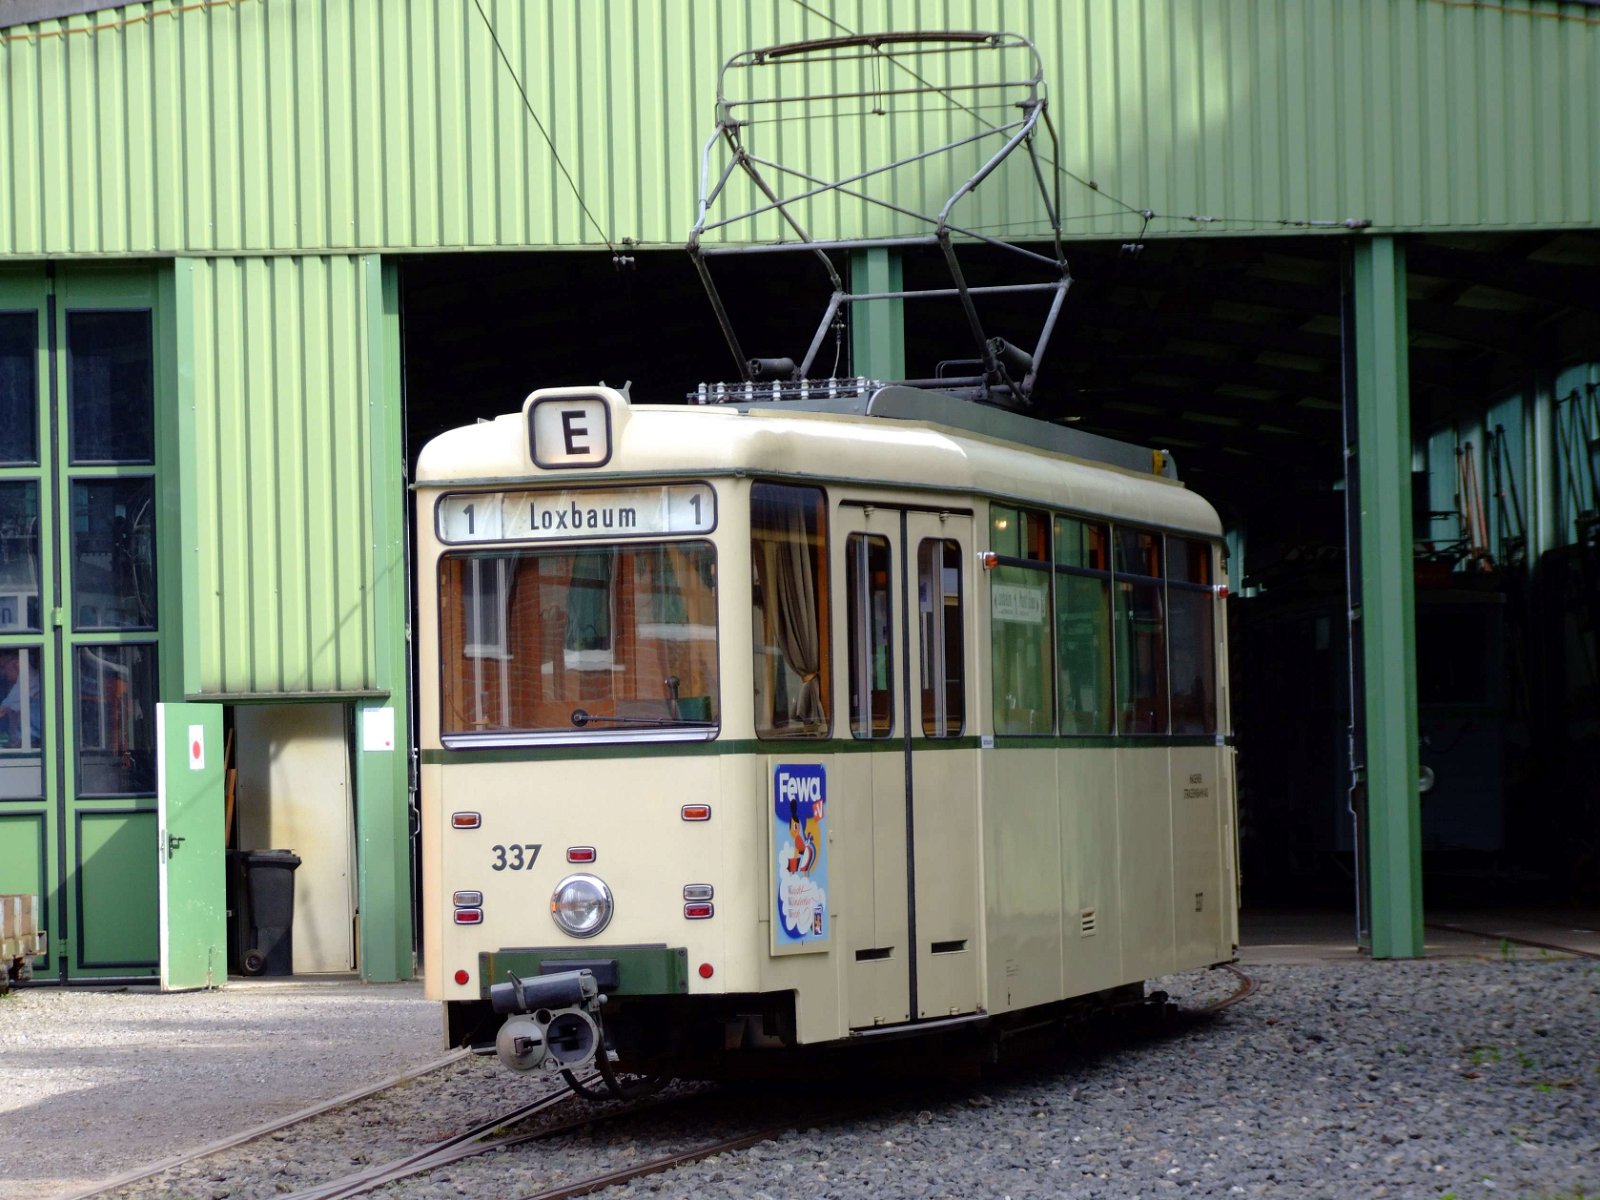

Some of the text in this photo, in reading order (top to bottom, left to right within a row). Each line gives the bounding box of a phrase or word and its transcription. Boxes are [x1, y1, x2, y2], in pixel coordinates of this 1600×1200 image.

[561, 410, 590, 455] E
[463, 493, 702, 535] 1 Loxbaum 1
[779, 772, 821, 802] Fewa
[491, 843, 543, 871] 337
